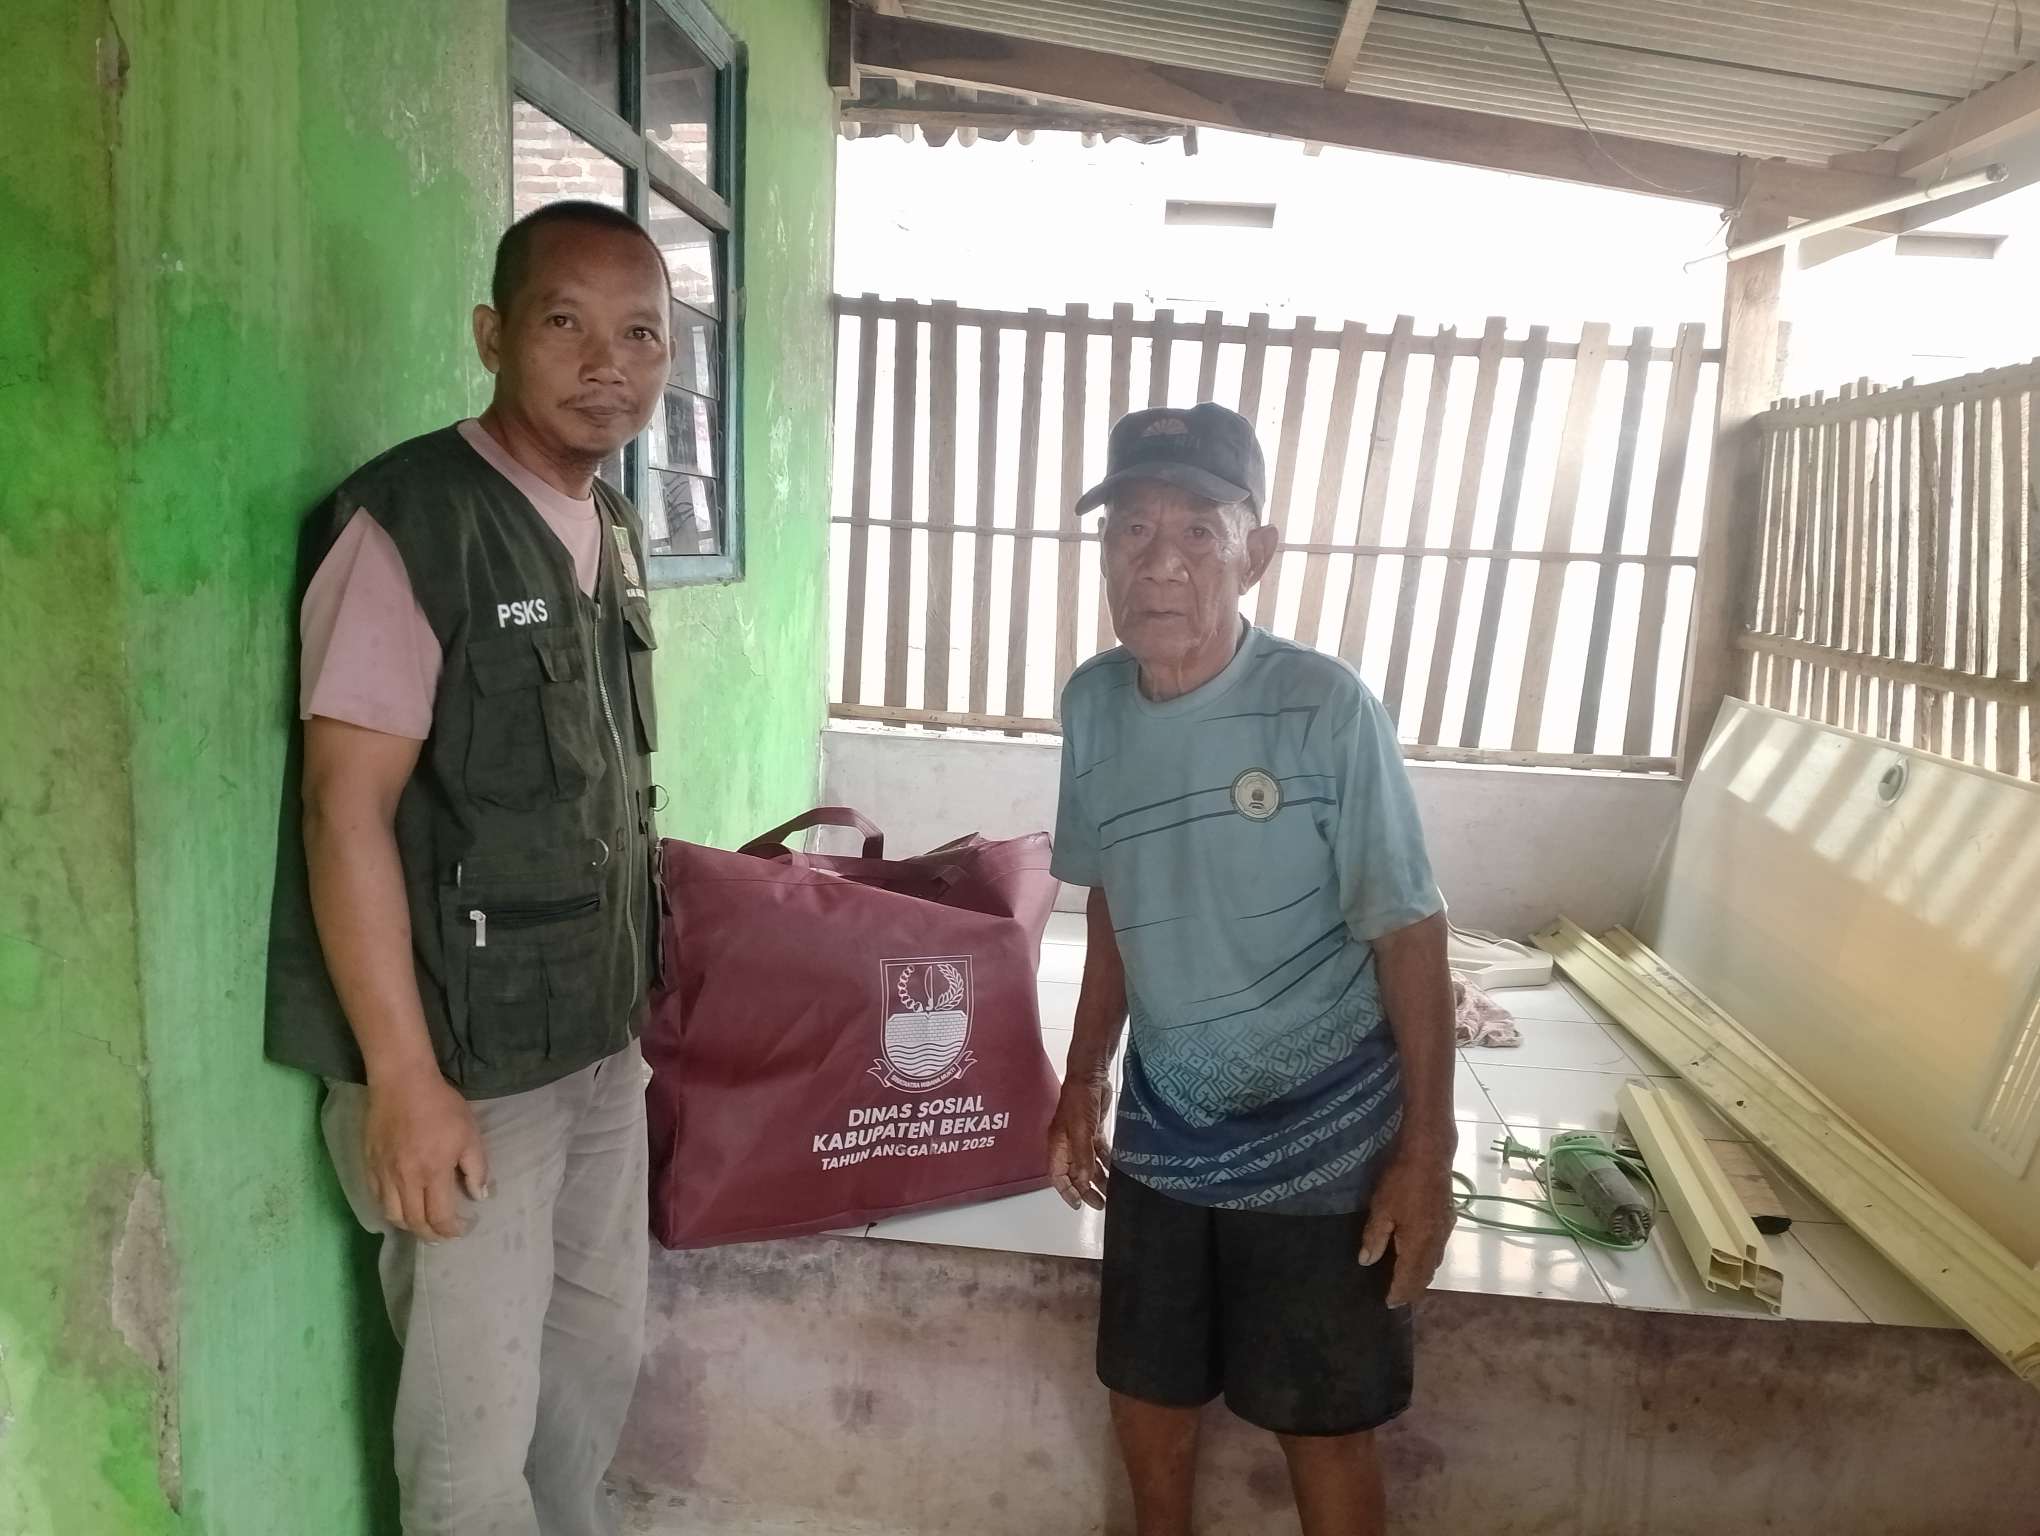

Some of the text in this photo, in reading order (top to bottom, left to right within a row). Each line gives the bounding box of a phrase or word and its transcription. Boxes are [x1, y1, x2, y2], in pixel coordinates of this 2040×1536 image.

[497, 598, 548, 628] PSKS
[848, 1095, 984, 1127] DINAS SOSIAL
[812, 1112, 1010, 1152] KABUPATEN BEKASI
[821, 1149, 869, 1171] TAHUN
[961, 1136, 995, 1151] 2025
